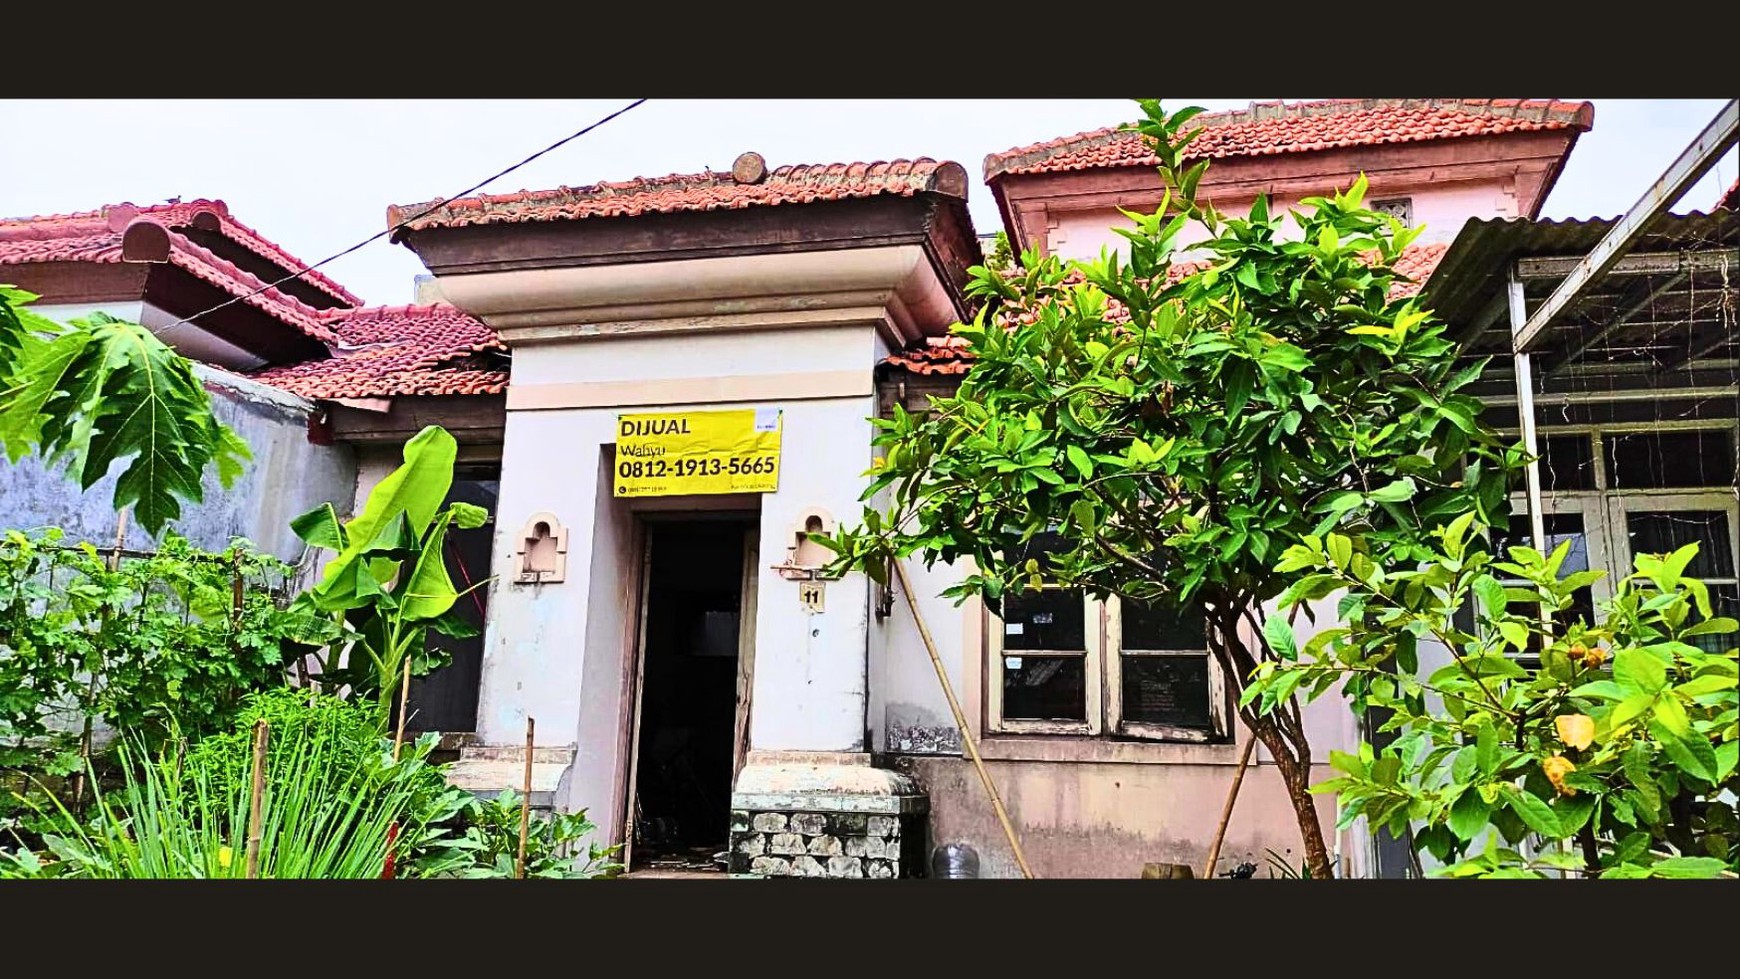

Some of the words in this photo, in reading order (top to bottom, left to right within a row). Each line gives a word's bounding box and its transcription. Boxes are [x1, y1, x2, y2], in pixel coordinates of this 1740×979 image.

[621, 418, 691, 436] DIJUAL
[620, 444, 666, 459] Wahyu
[619, 456, 775, 478] 0812-1913-5665
[804, 590, 819, 604] 11
